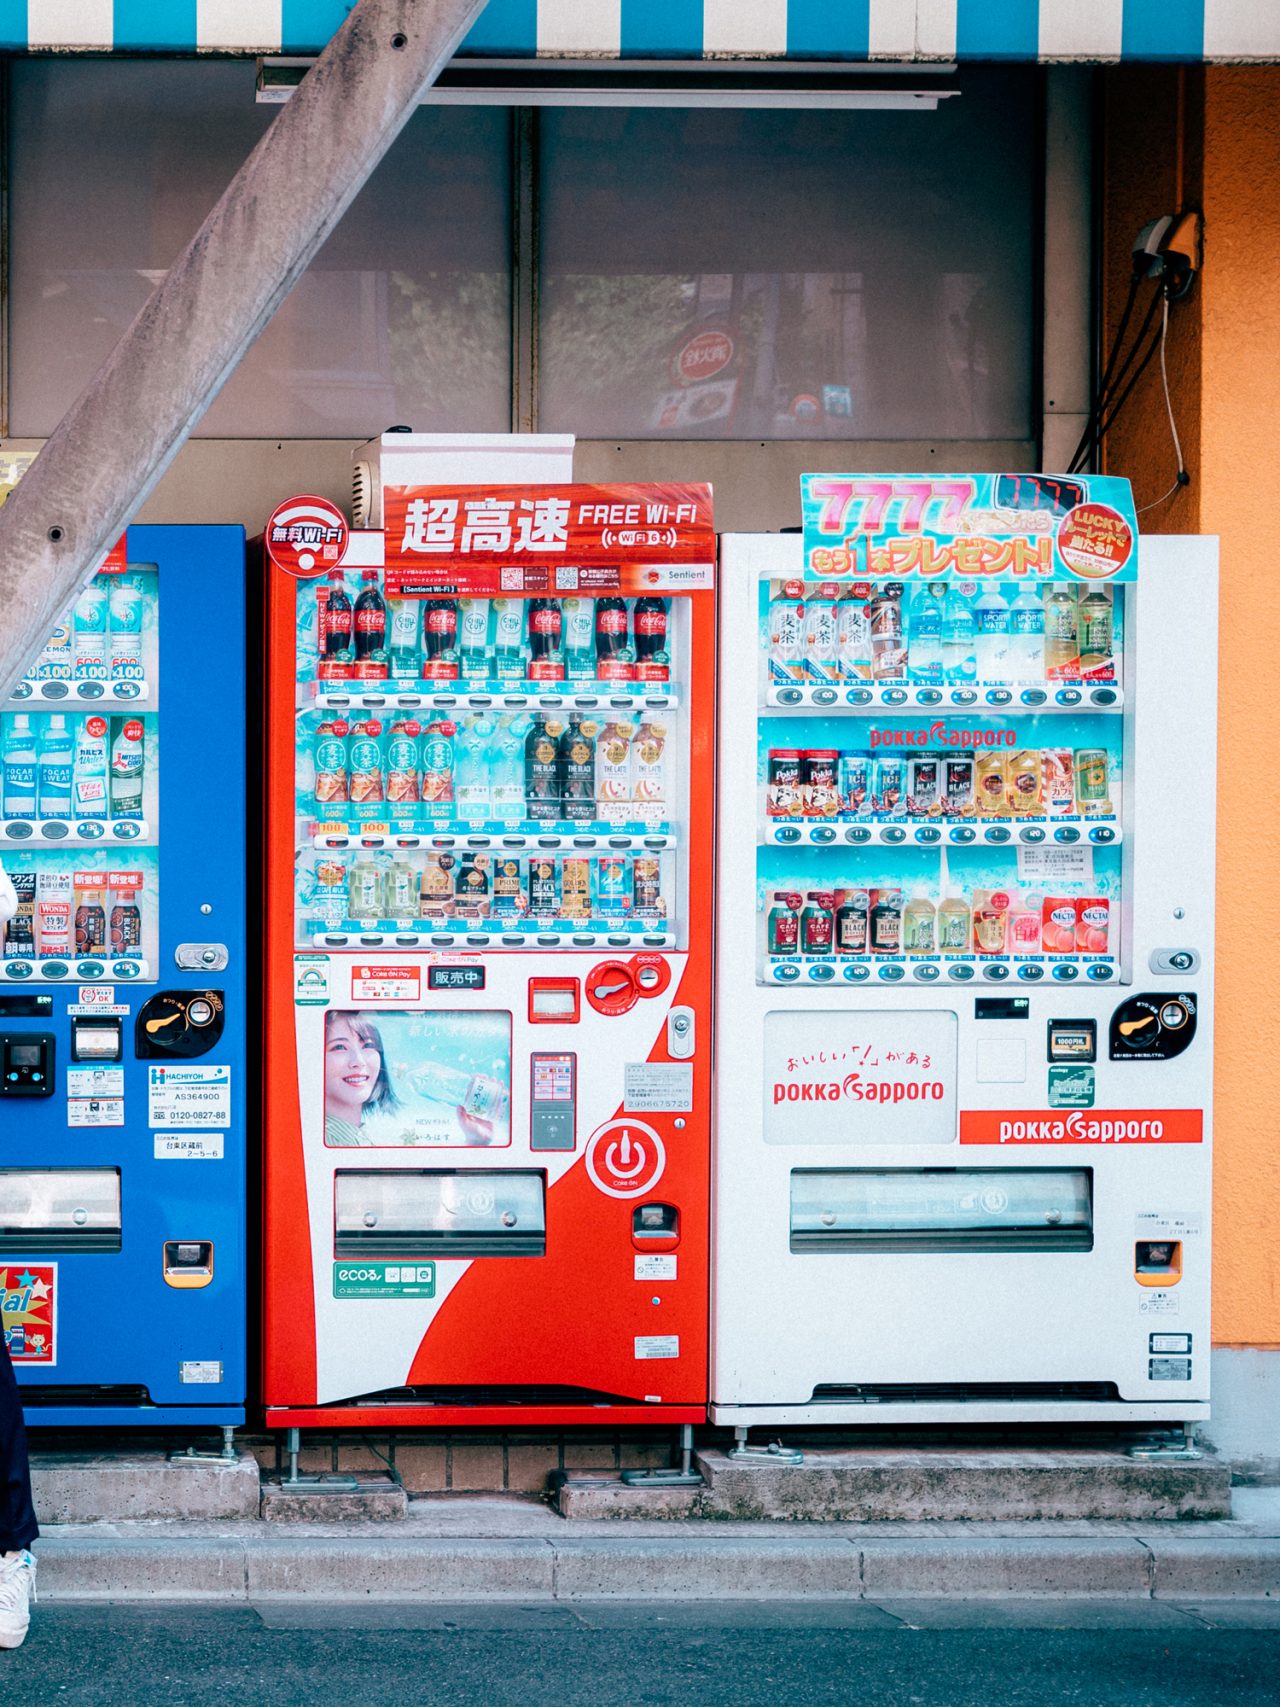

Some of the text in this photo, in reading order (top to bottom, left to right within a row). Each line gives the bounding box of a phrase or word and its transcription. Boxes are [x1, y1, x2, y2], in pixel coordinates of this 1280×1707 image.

[578, 503, 697, 524] FREE Wi-Fi
[814, 483, 971, 530] 7777
[401, 497, 571, 553] 超高速
[1074, 510, 1126, 532] LUCKY
[1064, 521, 1128, 548] ルーレットで
[669, 570, 705, 579] Sentient
[780, 613, 796, 645] 麦茶
[815, 613, 831, 645] 麦茶
[848, 613, 863, 645] 麦茶
[326, 743, 337, 768] 麦茶
[360, 743, 372, 768] 麦茶
[397, 742, 409, 767] 麦茶
[433, 742, 444, 767] 麦茶
[776, 769, 799, 780] Pokka
[811, 769, 833, 780] Pokka
[848, 775, 866, 783] ICE
[882, 775, 900, 783] ICE
[322, 823, 341, 832] 100
[363, 824, 385, 832] 100
[41, 904, 68, 913] WONDA
[46, 916, 64, 925] 特製
[435, 971, 478, 984] 販売中
[170, 1111, 226, 1119] 0120-0827-88
